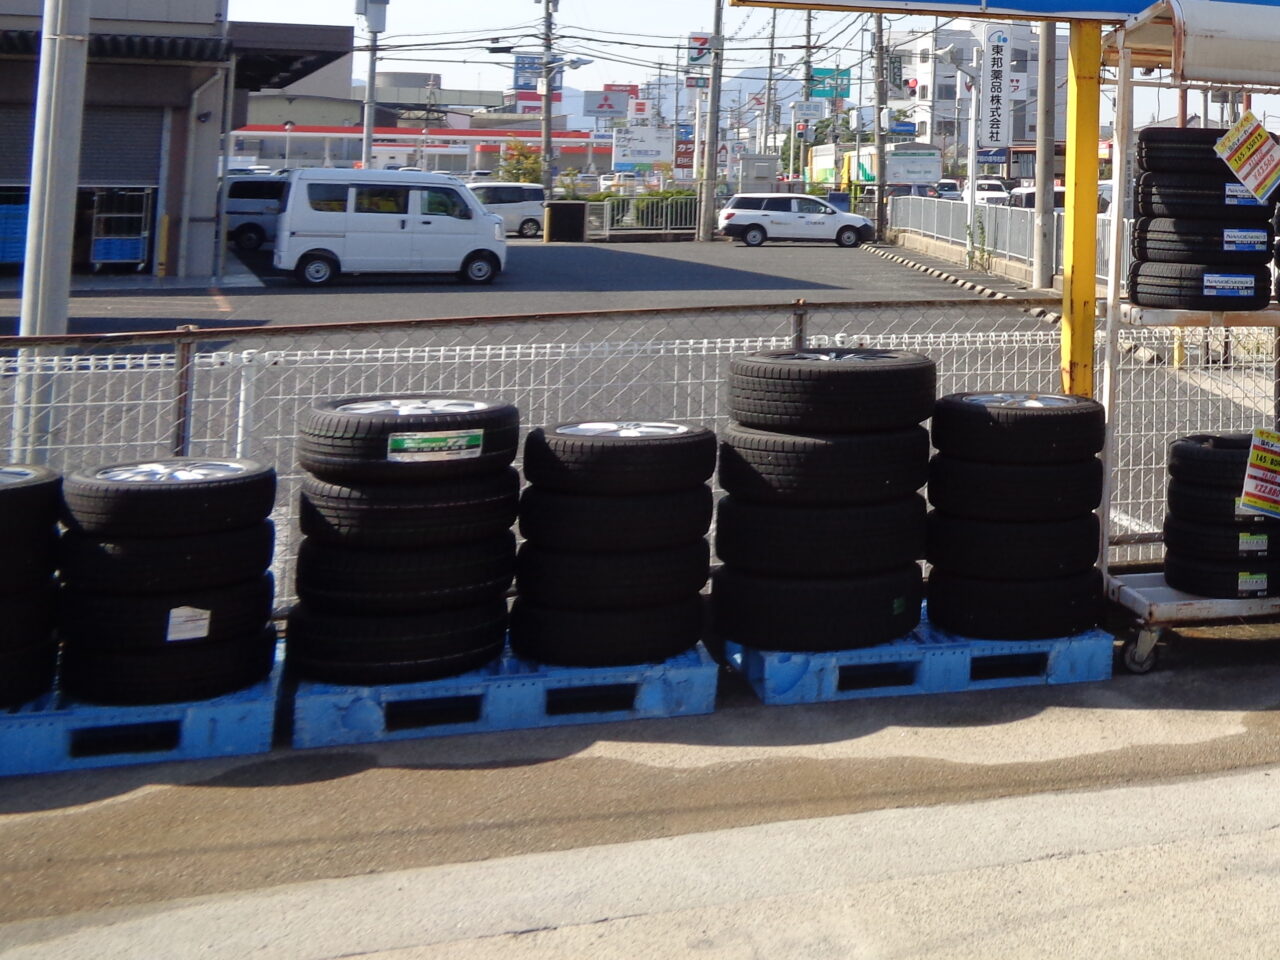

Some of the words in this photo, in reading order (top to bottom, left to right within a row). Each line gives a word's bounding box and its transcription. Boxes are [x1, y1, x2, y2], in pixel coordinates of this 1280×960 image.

[988, 44, 1004, 142] 東邦薬品株式会社
